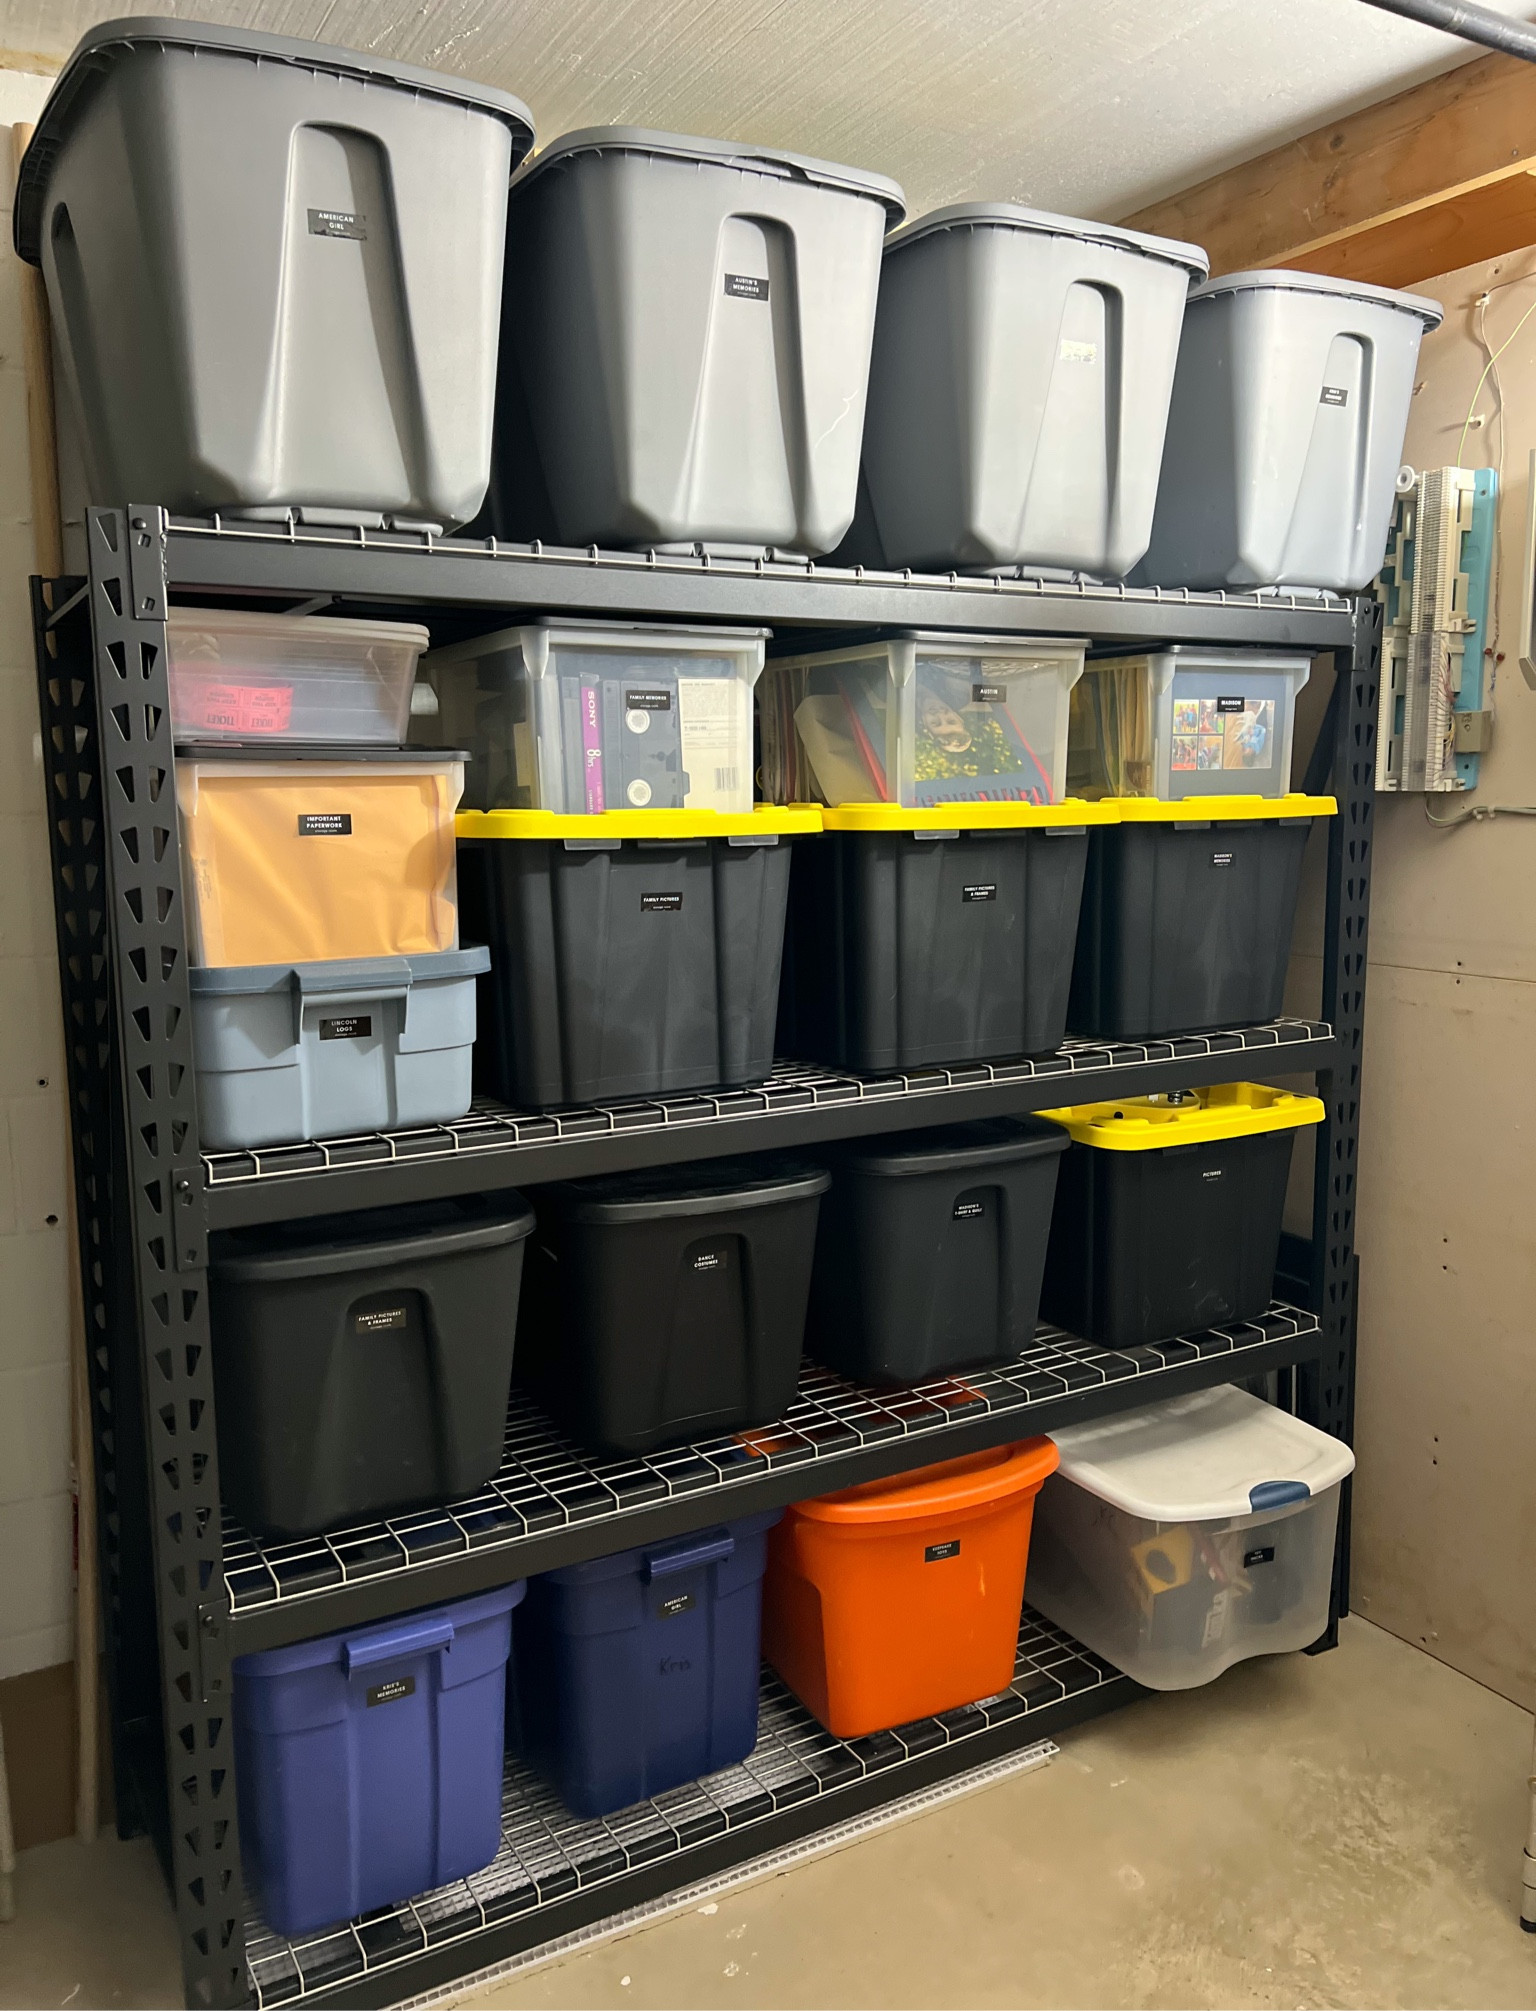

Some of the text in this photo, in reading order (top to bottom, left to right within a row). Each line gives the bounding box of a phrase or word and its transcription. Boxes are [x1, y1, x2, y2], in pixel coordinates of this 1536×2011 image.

[318, 212, 354, 223] AMERICAN
[329, 222, 344, 230] GIRL
[732, 283, 759, 293] MEMORIES
[588, 691, 596, 727] SONY
[207, 714, 235, 726] TICKET
[251, 717, 273, 728] TICKET
[694, 1259, 718, 1268] COSTUMES
[697, 1254, 715, 1262] DANCE
[378, 1310, 401, 1318] PICTURES
[664, 1595, 688, 1607] AMERICAN
[377, 1685, 406, 1698] MEMORIES
